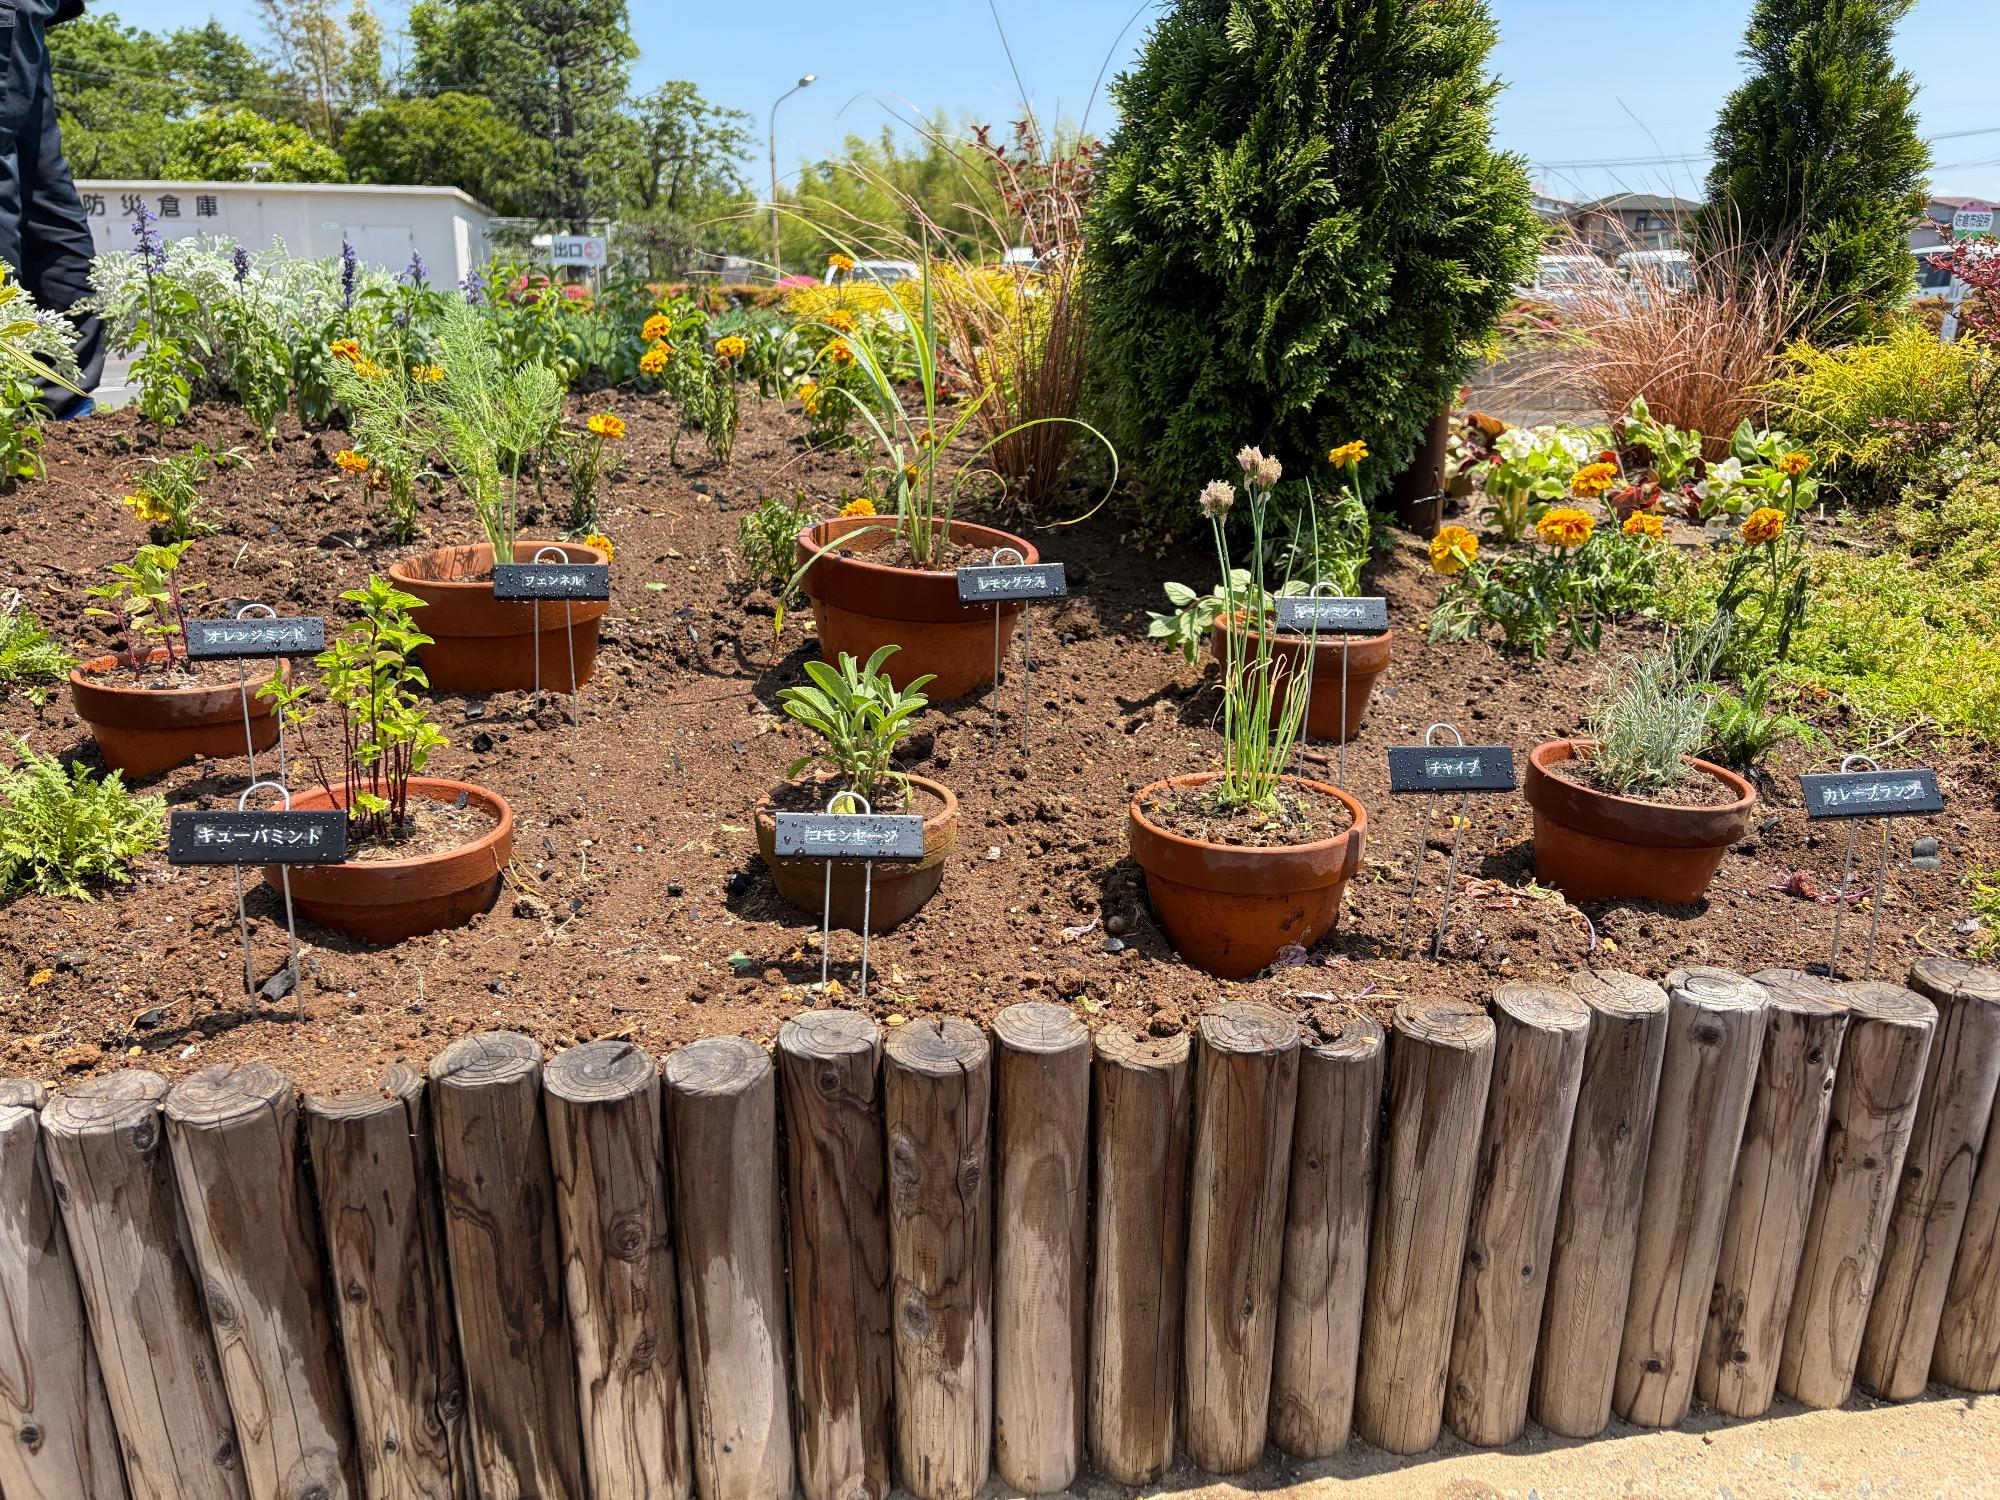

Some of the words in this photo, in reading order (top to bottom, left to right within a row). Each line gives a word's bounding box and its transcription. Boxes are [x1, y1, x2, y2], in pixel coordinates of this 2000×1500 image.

[83, 194, 219, 217] 防災倉庫
[554, 242, 583, 258] 出口
[524, 575, 583, 587] フェンネル
[197, 827, 320, 845] キューバミント
